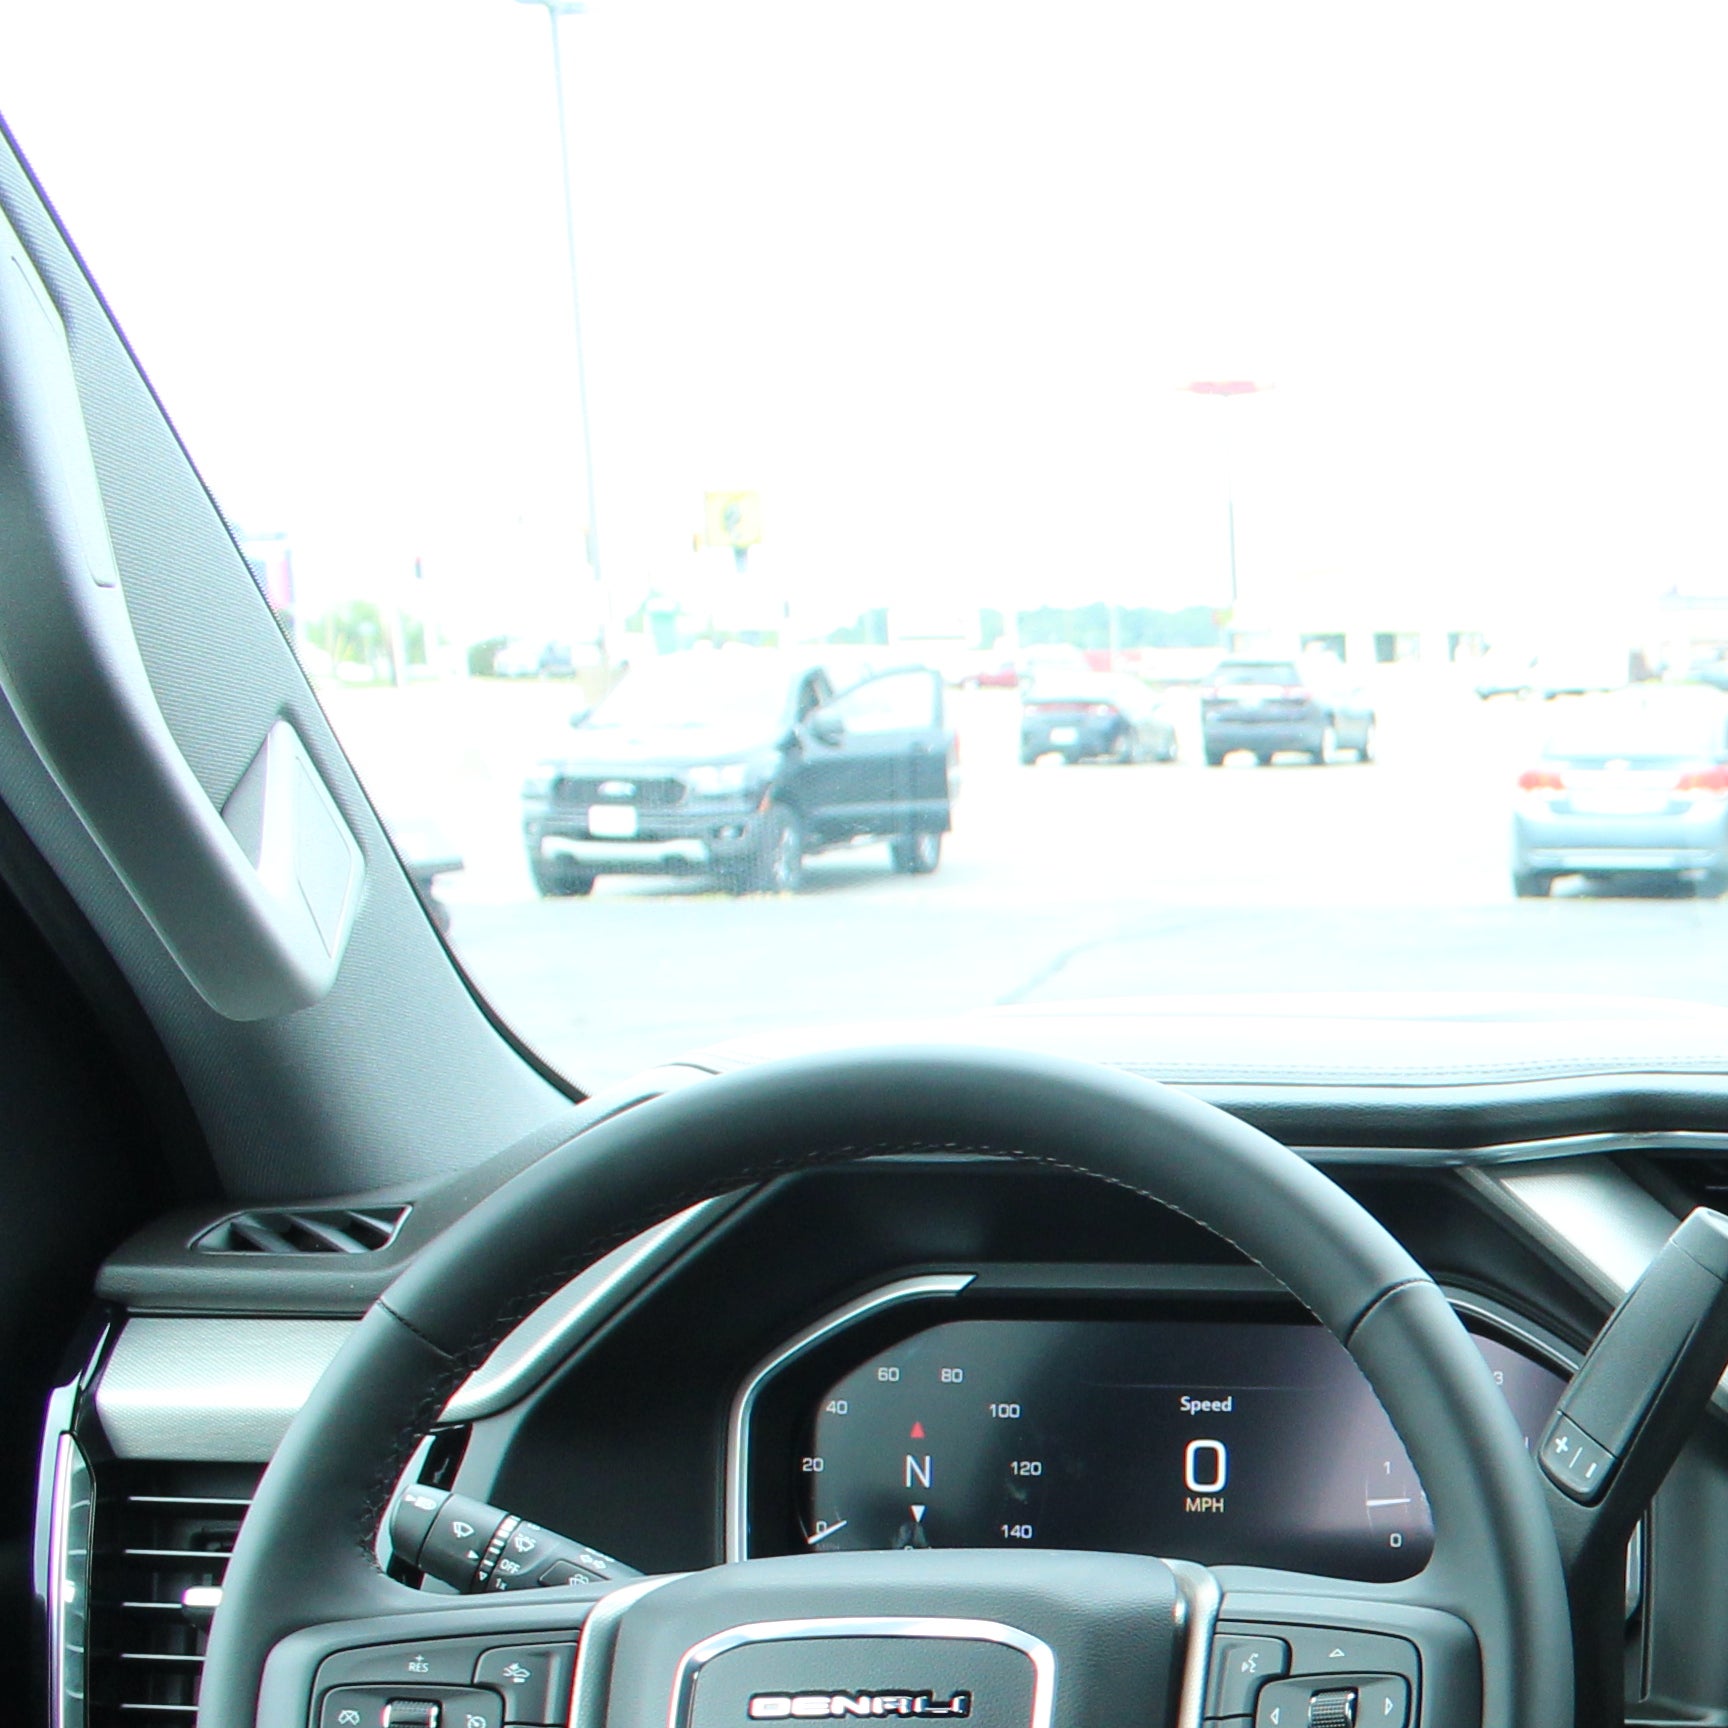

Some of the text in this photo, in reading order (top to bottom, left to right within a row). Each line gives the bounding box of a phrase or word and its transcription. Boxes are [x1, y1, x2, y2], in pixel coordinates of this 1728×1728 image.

[878, 1367, 963, 1383] 60 80
[1493, 1371, 1504, 1385] 3
[825, 1400, 1020, 1419] 40 100
[1180, 1396, 1233, 1416] Speed
[802, 1458, 1042, 1476] 20 120
[905, 1454, 934, 1489] N
[1184, 1438, 1231, 1493] 0
[1383, 1460, 1391, 1475] 1
[1185, 1497, 1226, 1513] MPH
[815, 1521, 1033, 1540] 0 140
[1389, 1533, 1402, 1548] 0
[500, 1558, 521, 1575] OFF
[408, 1661, 430, 1674] RES
[748, 1689, 973, 1720] DENALI
